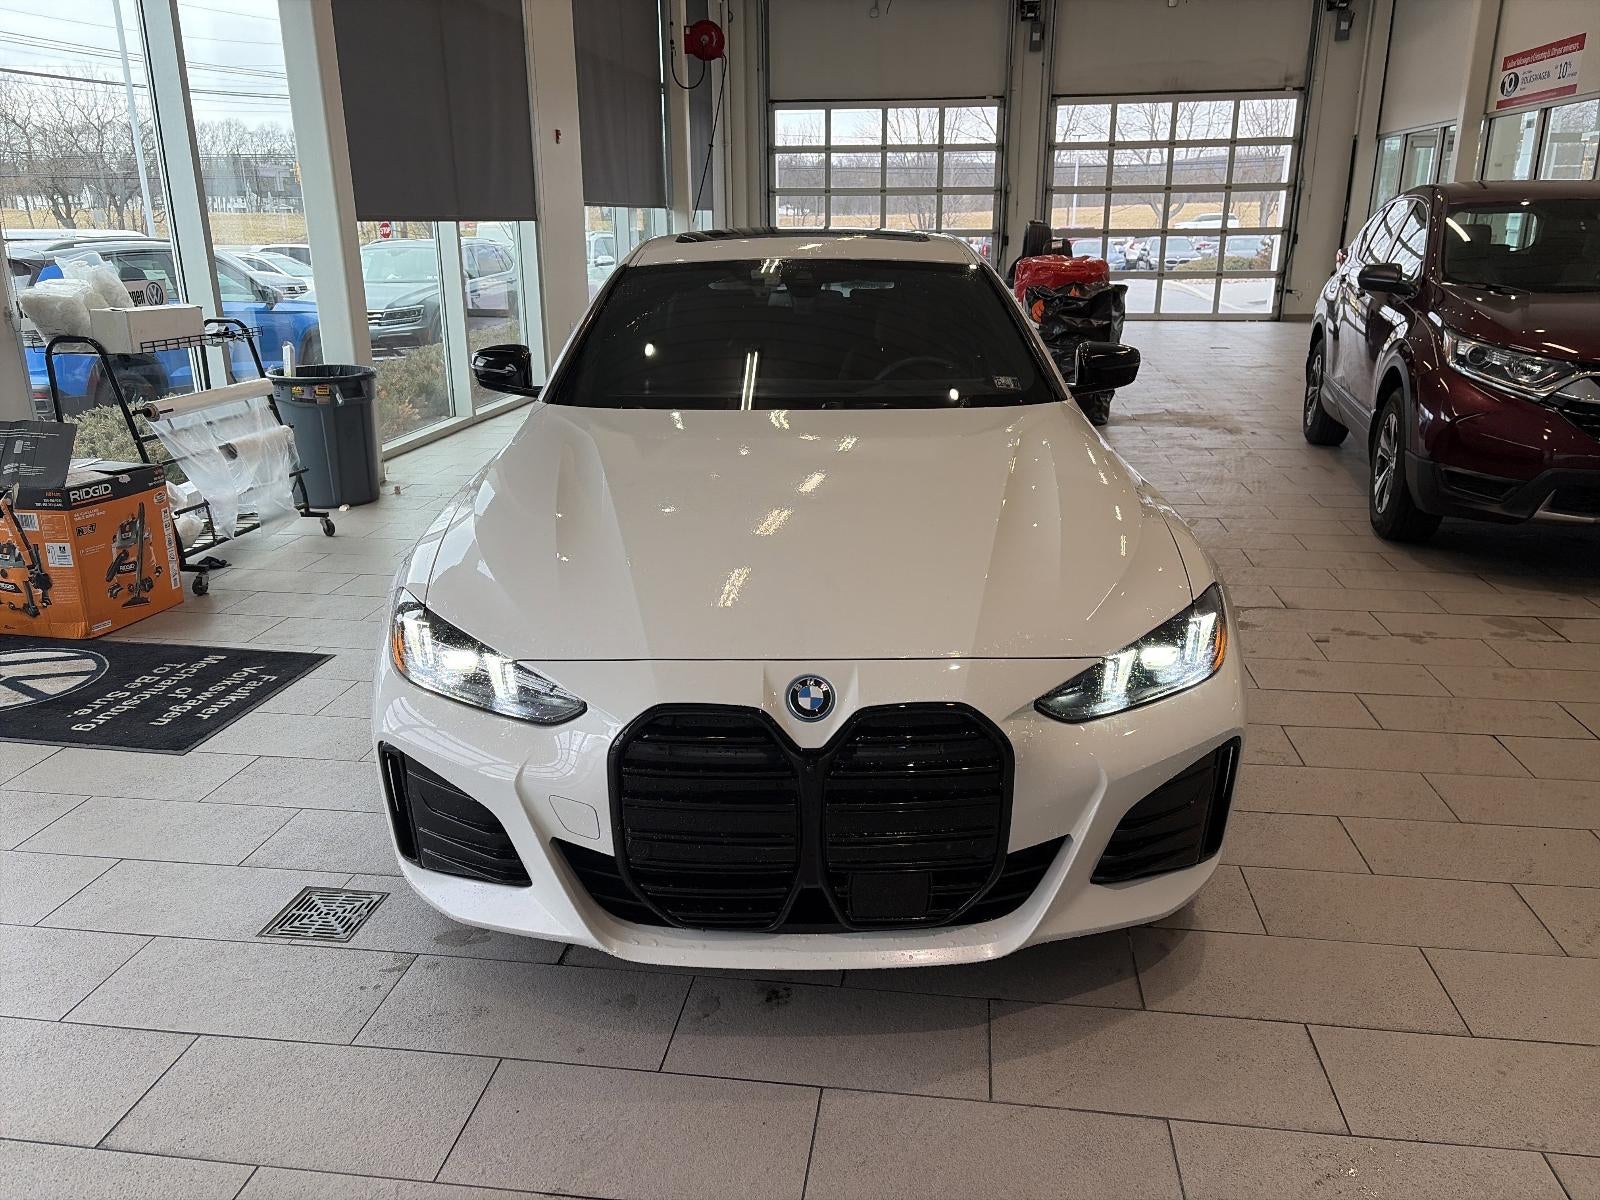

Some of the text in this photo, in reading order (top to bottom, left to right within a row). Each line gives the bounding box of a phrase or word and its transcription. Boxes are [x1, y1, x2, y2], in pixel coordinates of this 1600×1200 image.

[69, 483, 113, 502] RIDGID
[66, 662, 187, 718] To Be Sure.
[71, 655, 228, 732] Mechanicsburg
[149, 665, 265, 727] Volkswagen
[167, 687, 193, 698] of
[195, 674, 277, 720] Faulkner
[794, 680, 830, 692] BMW
